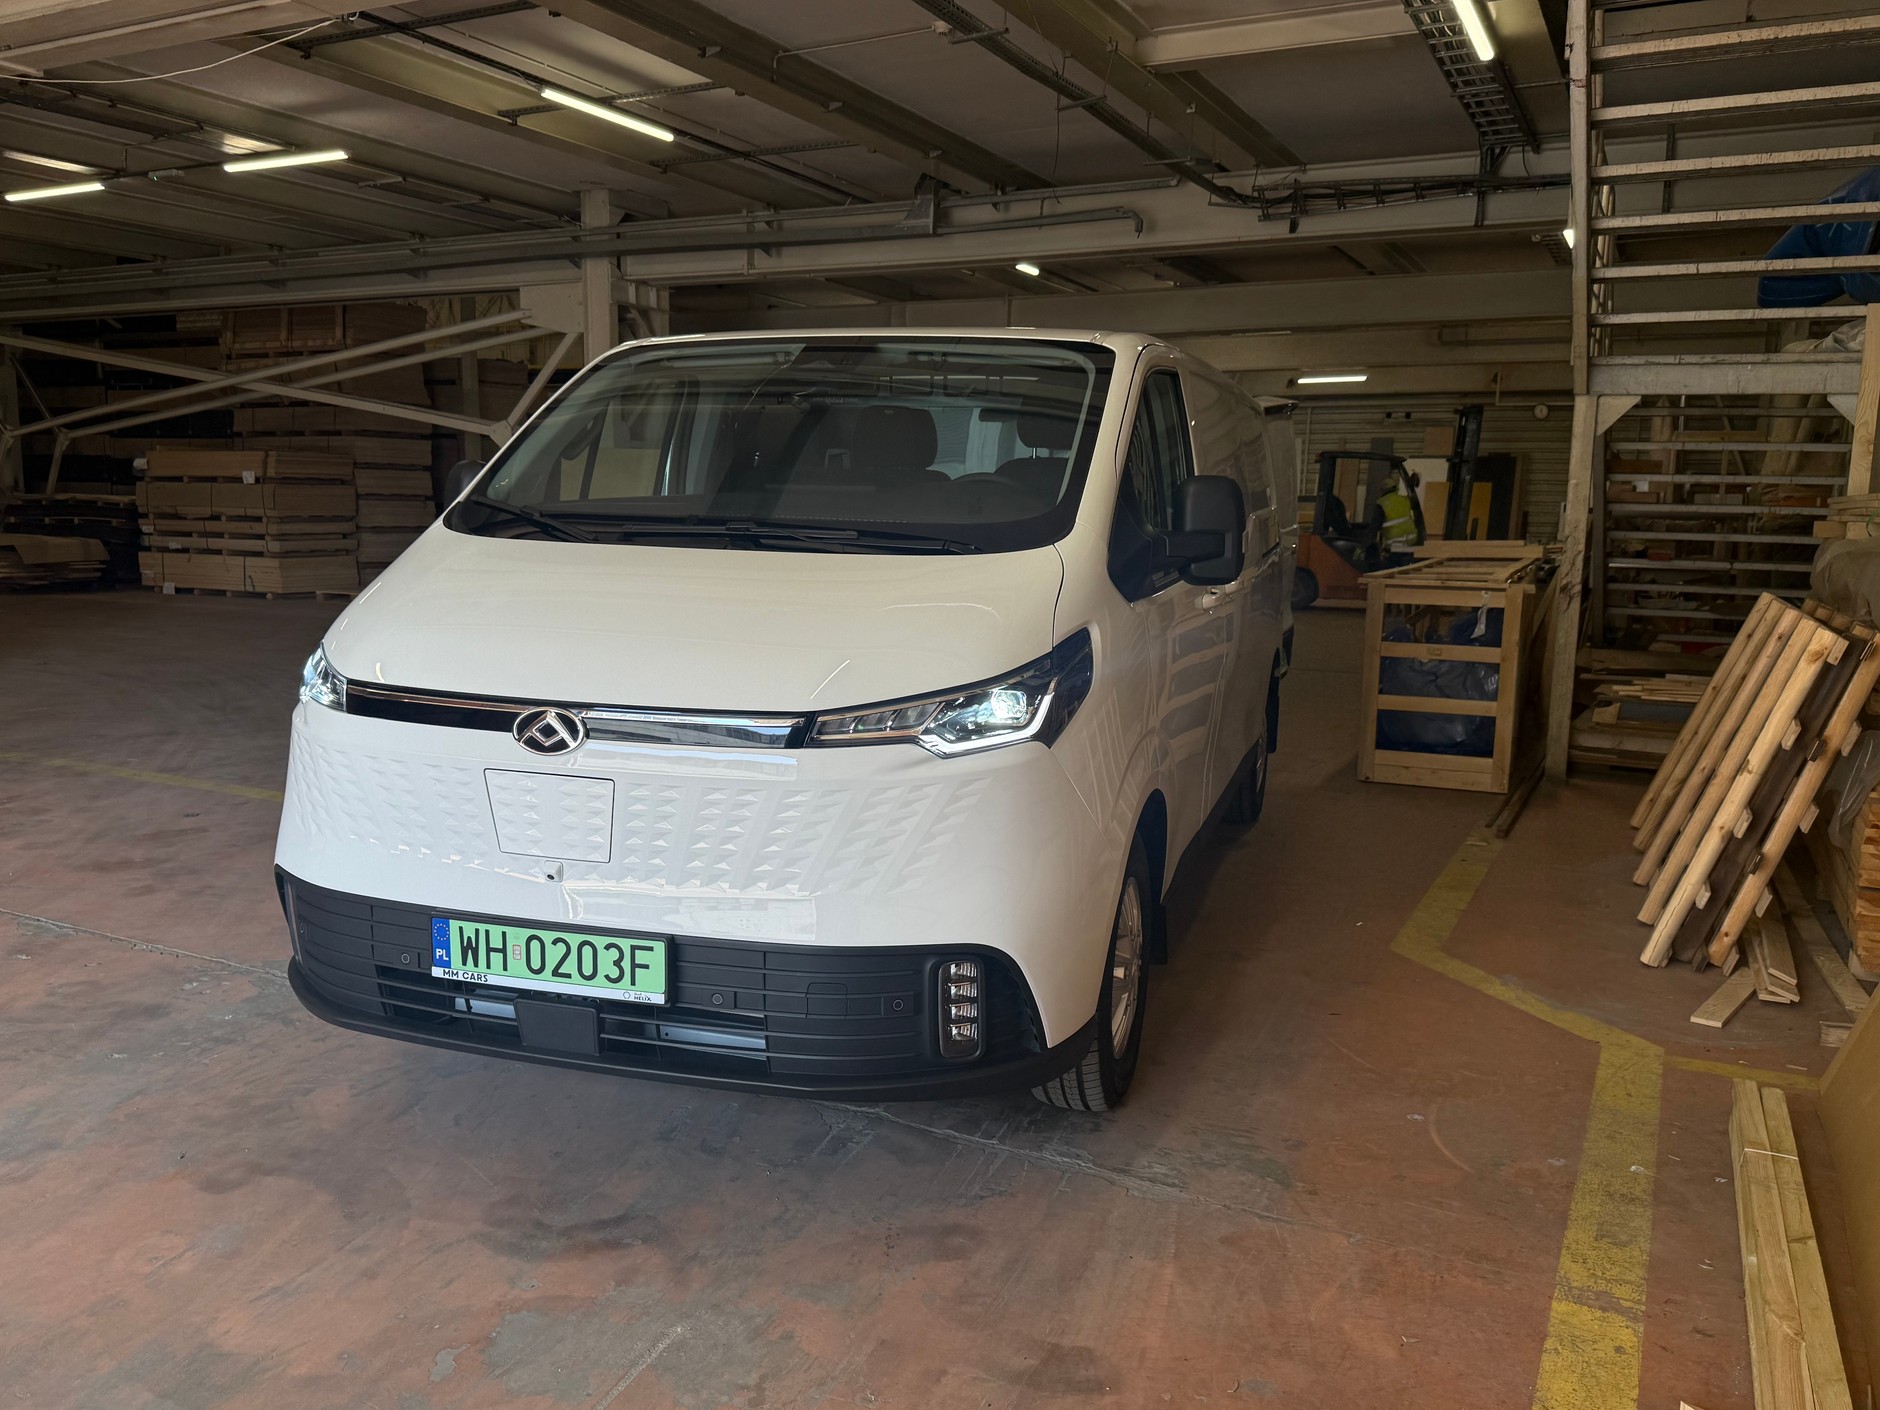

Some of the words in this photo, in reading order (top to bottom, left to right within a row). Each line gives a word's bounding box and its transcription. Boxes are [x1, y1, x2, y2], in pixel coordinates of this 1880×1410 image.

[435, 948, 449, 961] PL
[458, 925, 508, 972] WH
[525, 933, 654, 987] 0203F
[442, 968, 459, 978] MM
[462, 971, 489, 983] CARS
